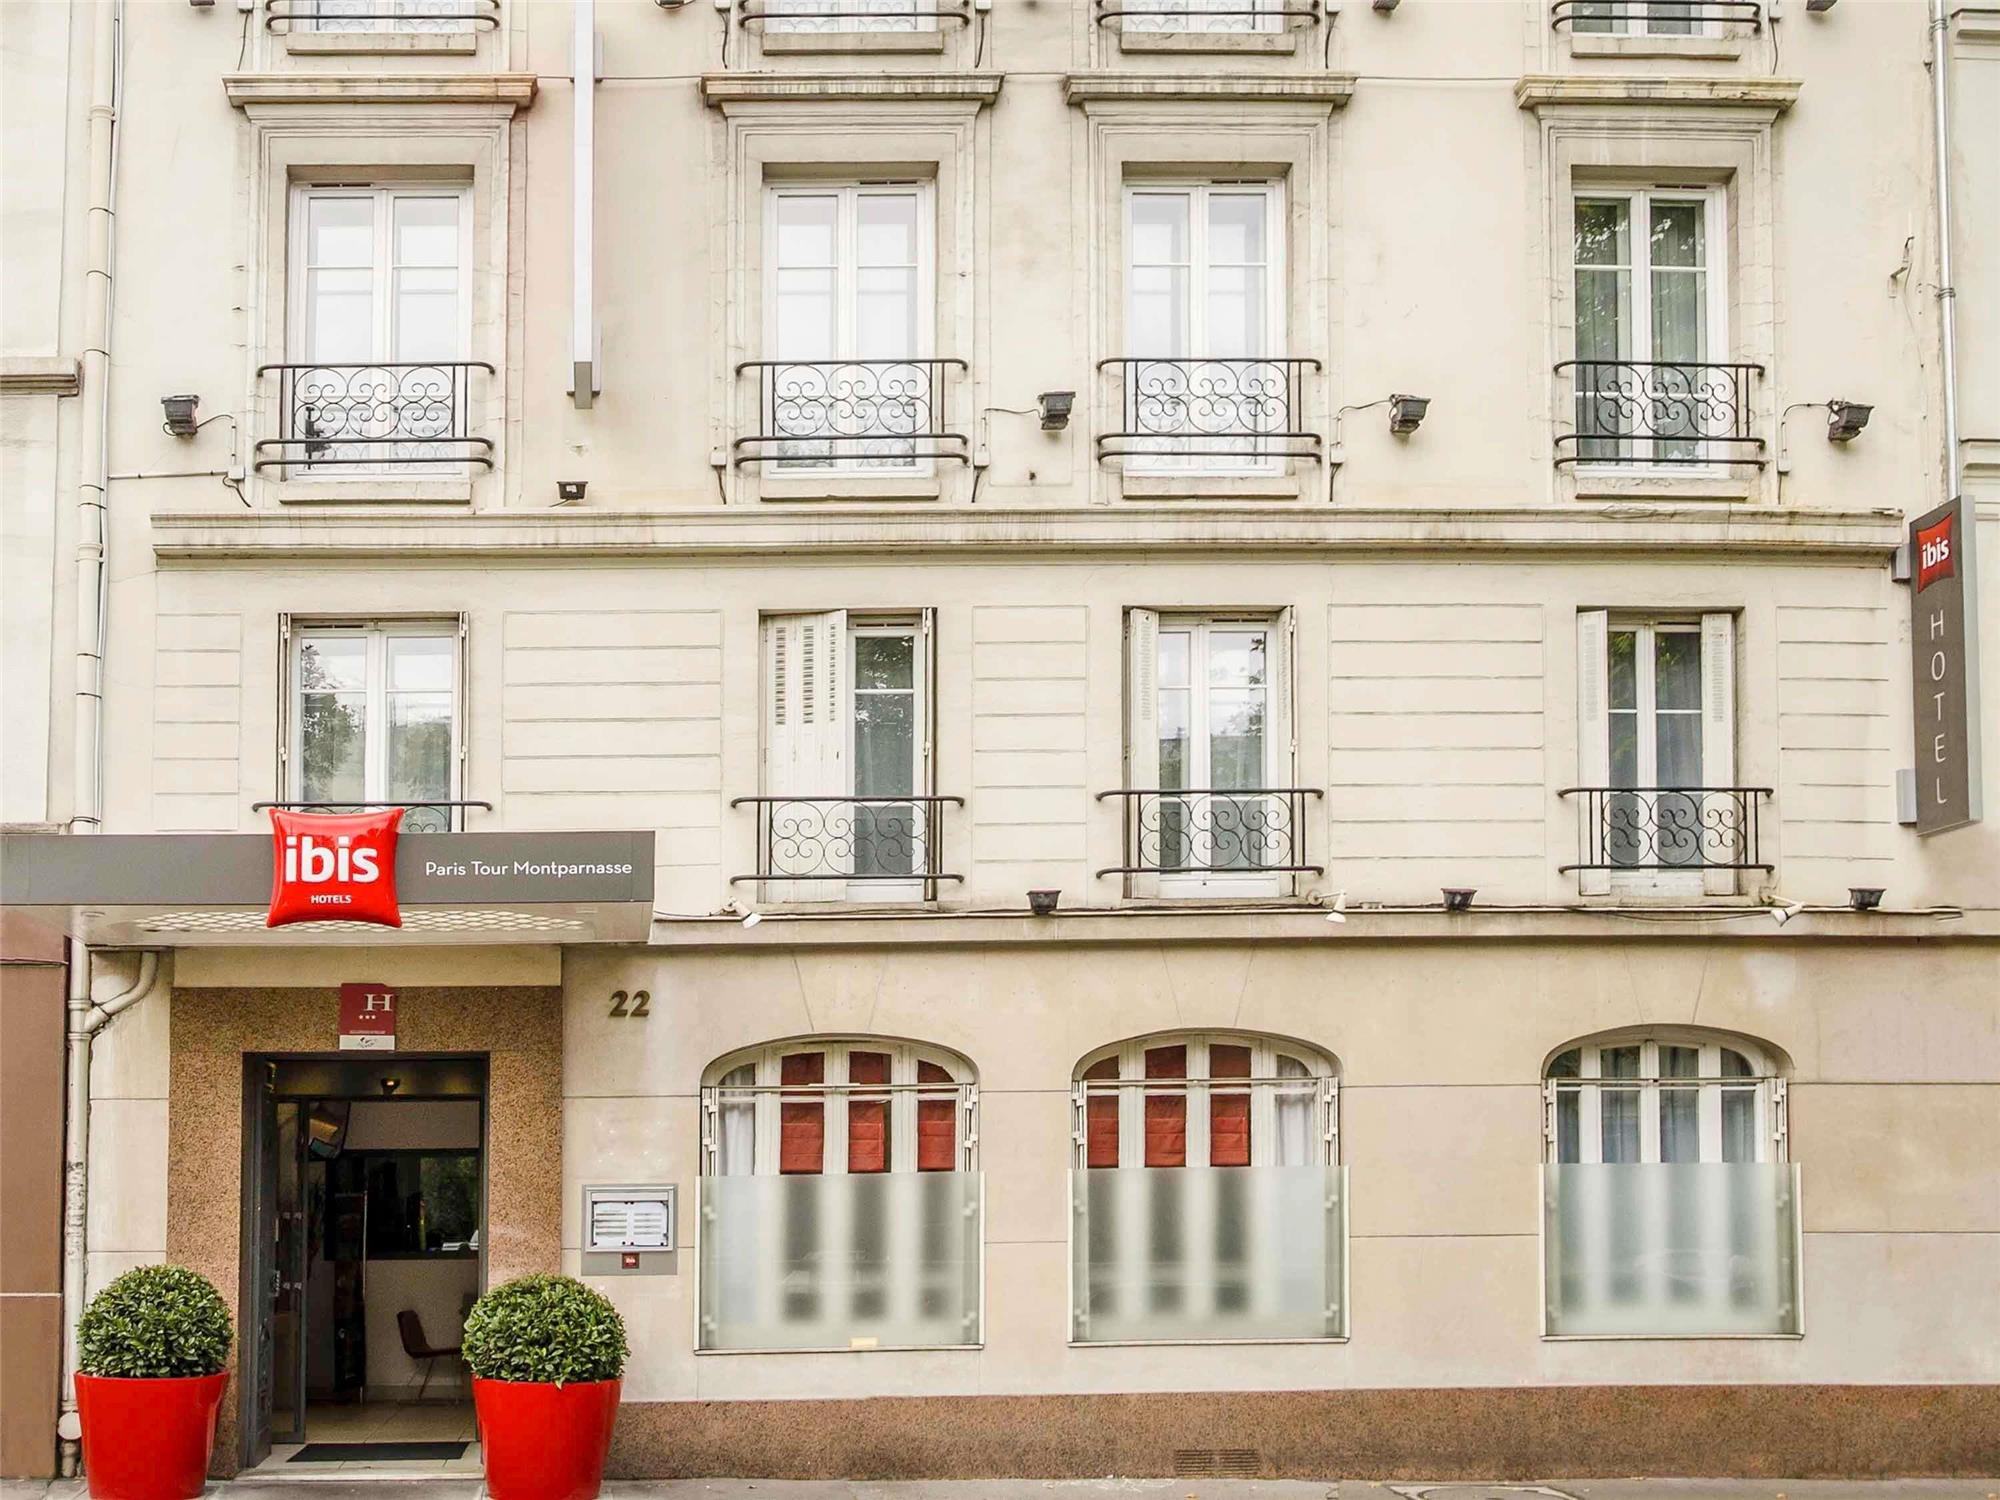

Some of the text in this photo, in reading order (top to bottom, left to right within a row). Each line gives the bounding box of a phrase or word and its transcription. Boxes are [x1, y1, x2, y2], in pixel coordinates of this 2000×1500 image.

[1922, 536, 1950, 570] ibis
[1930, 609, 1948, 804] HOTEL
[285, 835, 379, 883] ibis
[425, 861, 633, 878] Paris Tour Montparnasse
[311, 895, 352, 904] HOTELS
[363, 993, 394, 1012] H
[608, 990, 651, 1018] 22
